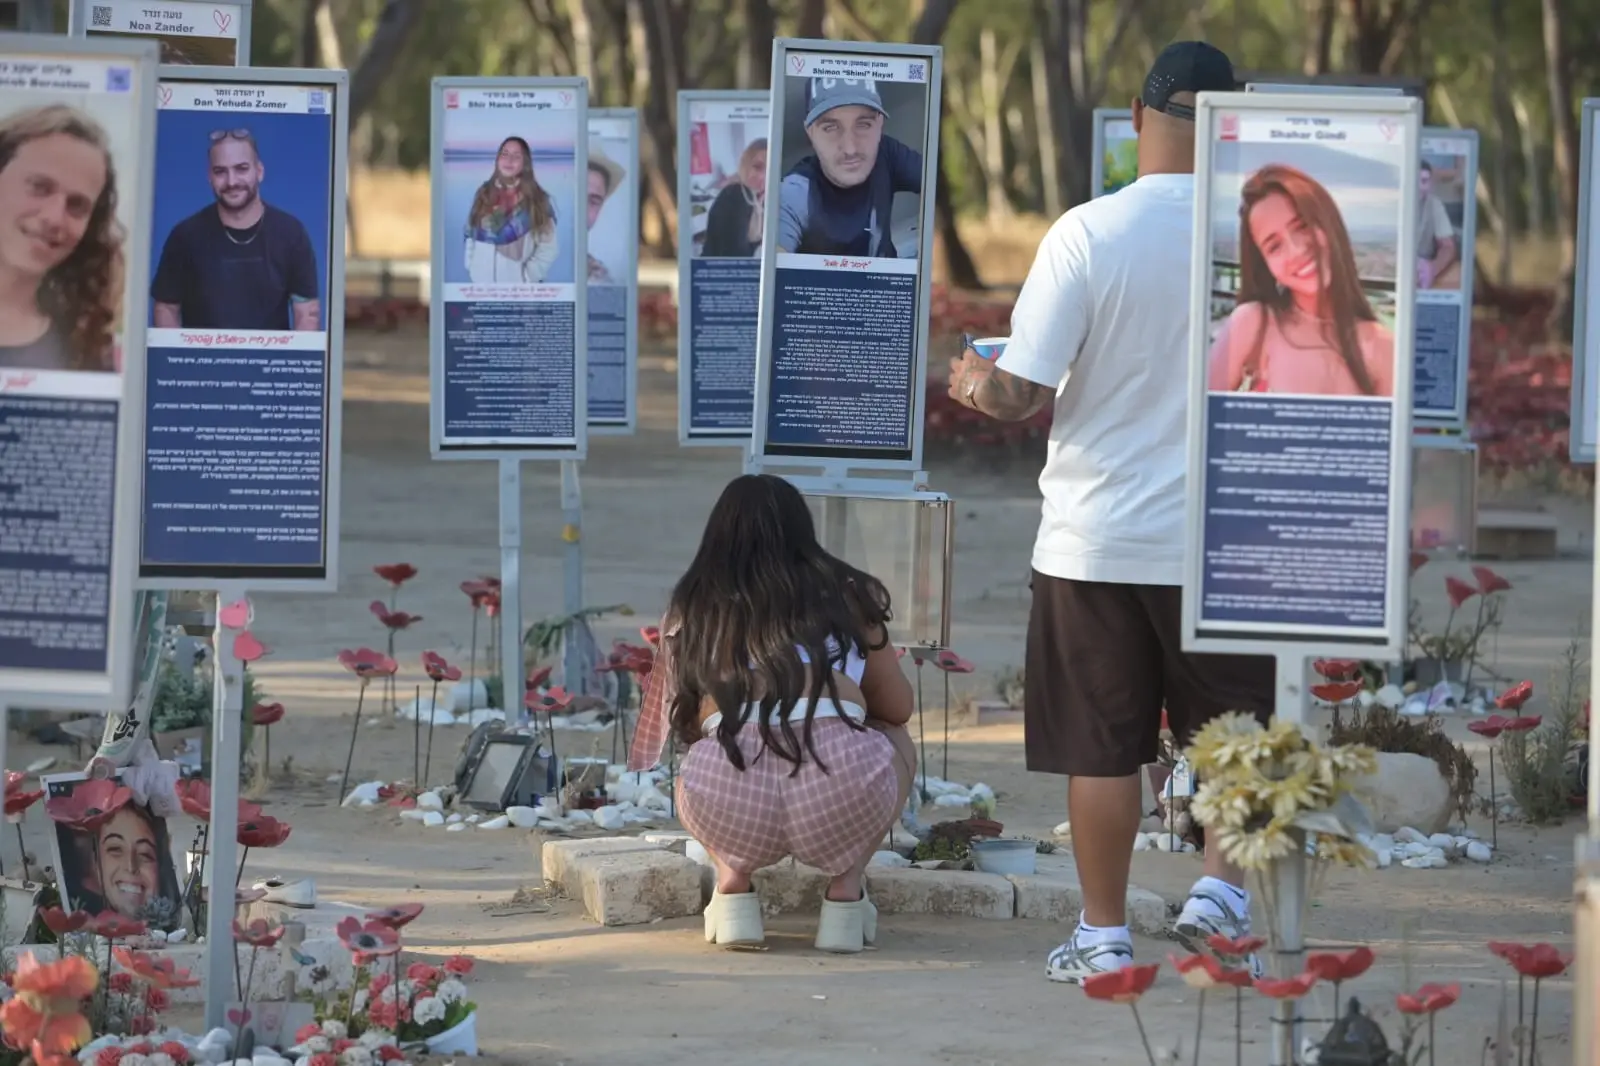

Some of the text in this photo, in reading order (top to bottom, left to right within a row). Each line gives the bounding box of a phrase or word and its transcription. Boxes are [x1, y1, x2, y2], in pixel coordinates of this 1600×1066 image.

[129, 20, 195, 33] Noa Zander
[812, 68, 841, 76] Shimon
[872, 71, 894, 80] Hayat
[193, 98, 288, 109] Dan Yehuda Zomer
[468, 100, 486, 108] Shir
[489, 101, 513, 109] Hana
[1269, 129, 1347, 140] Shahar Gindi
